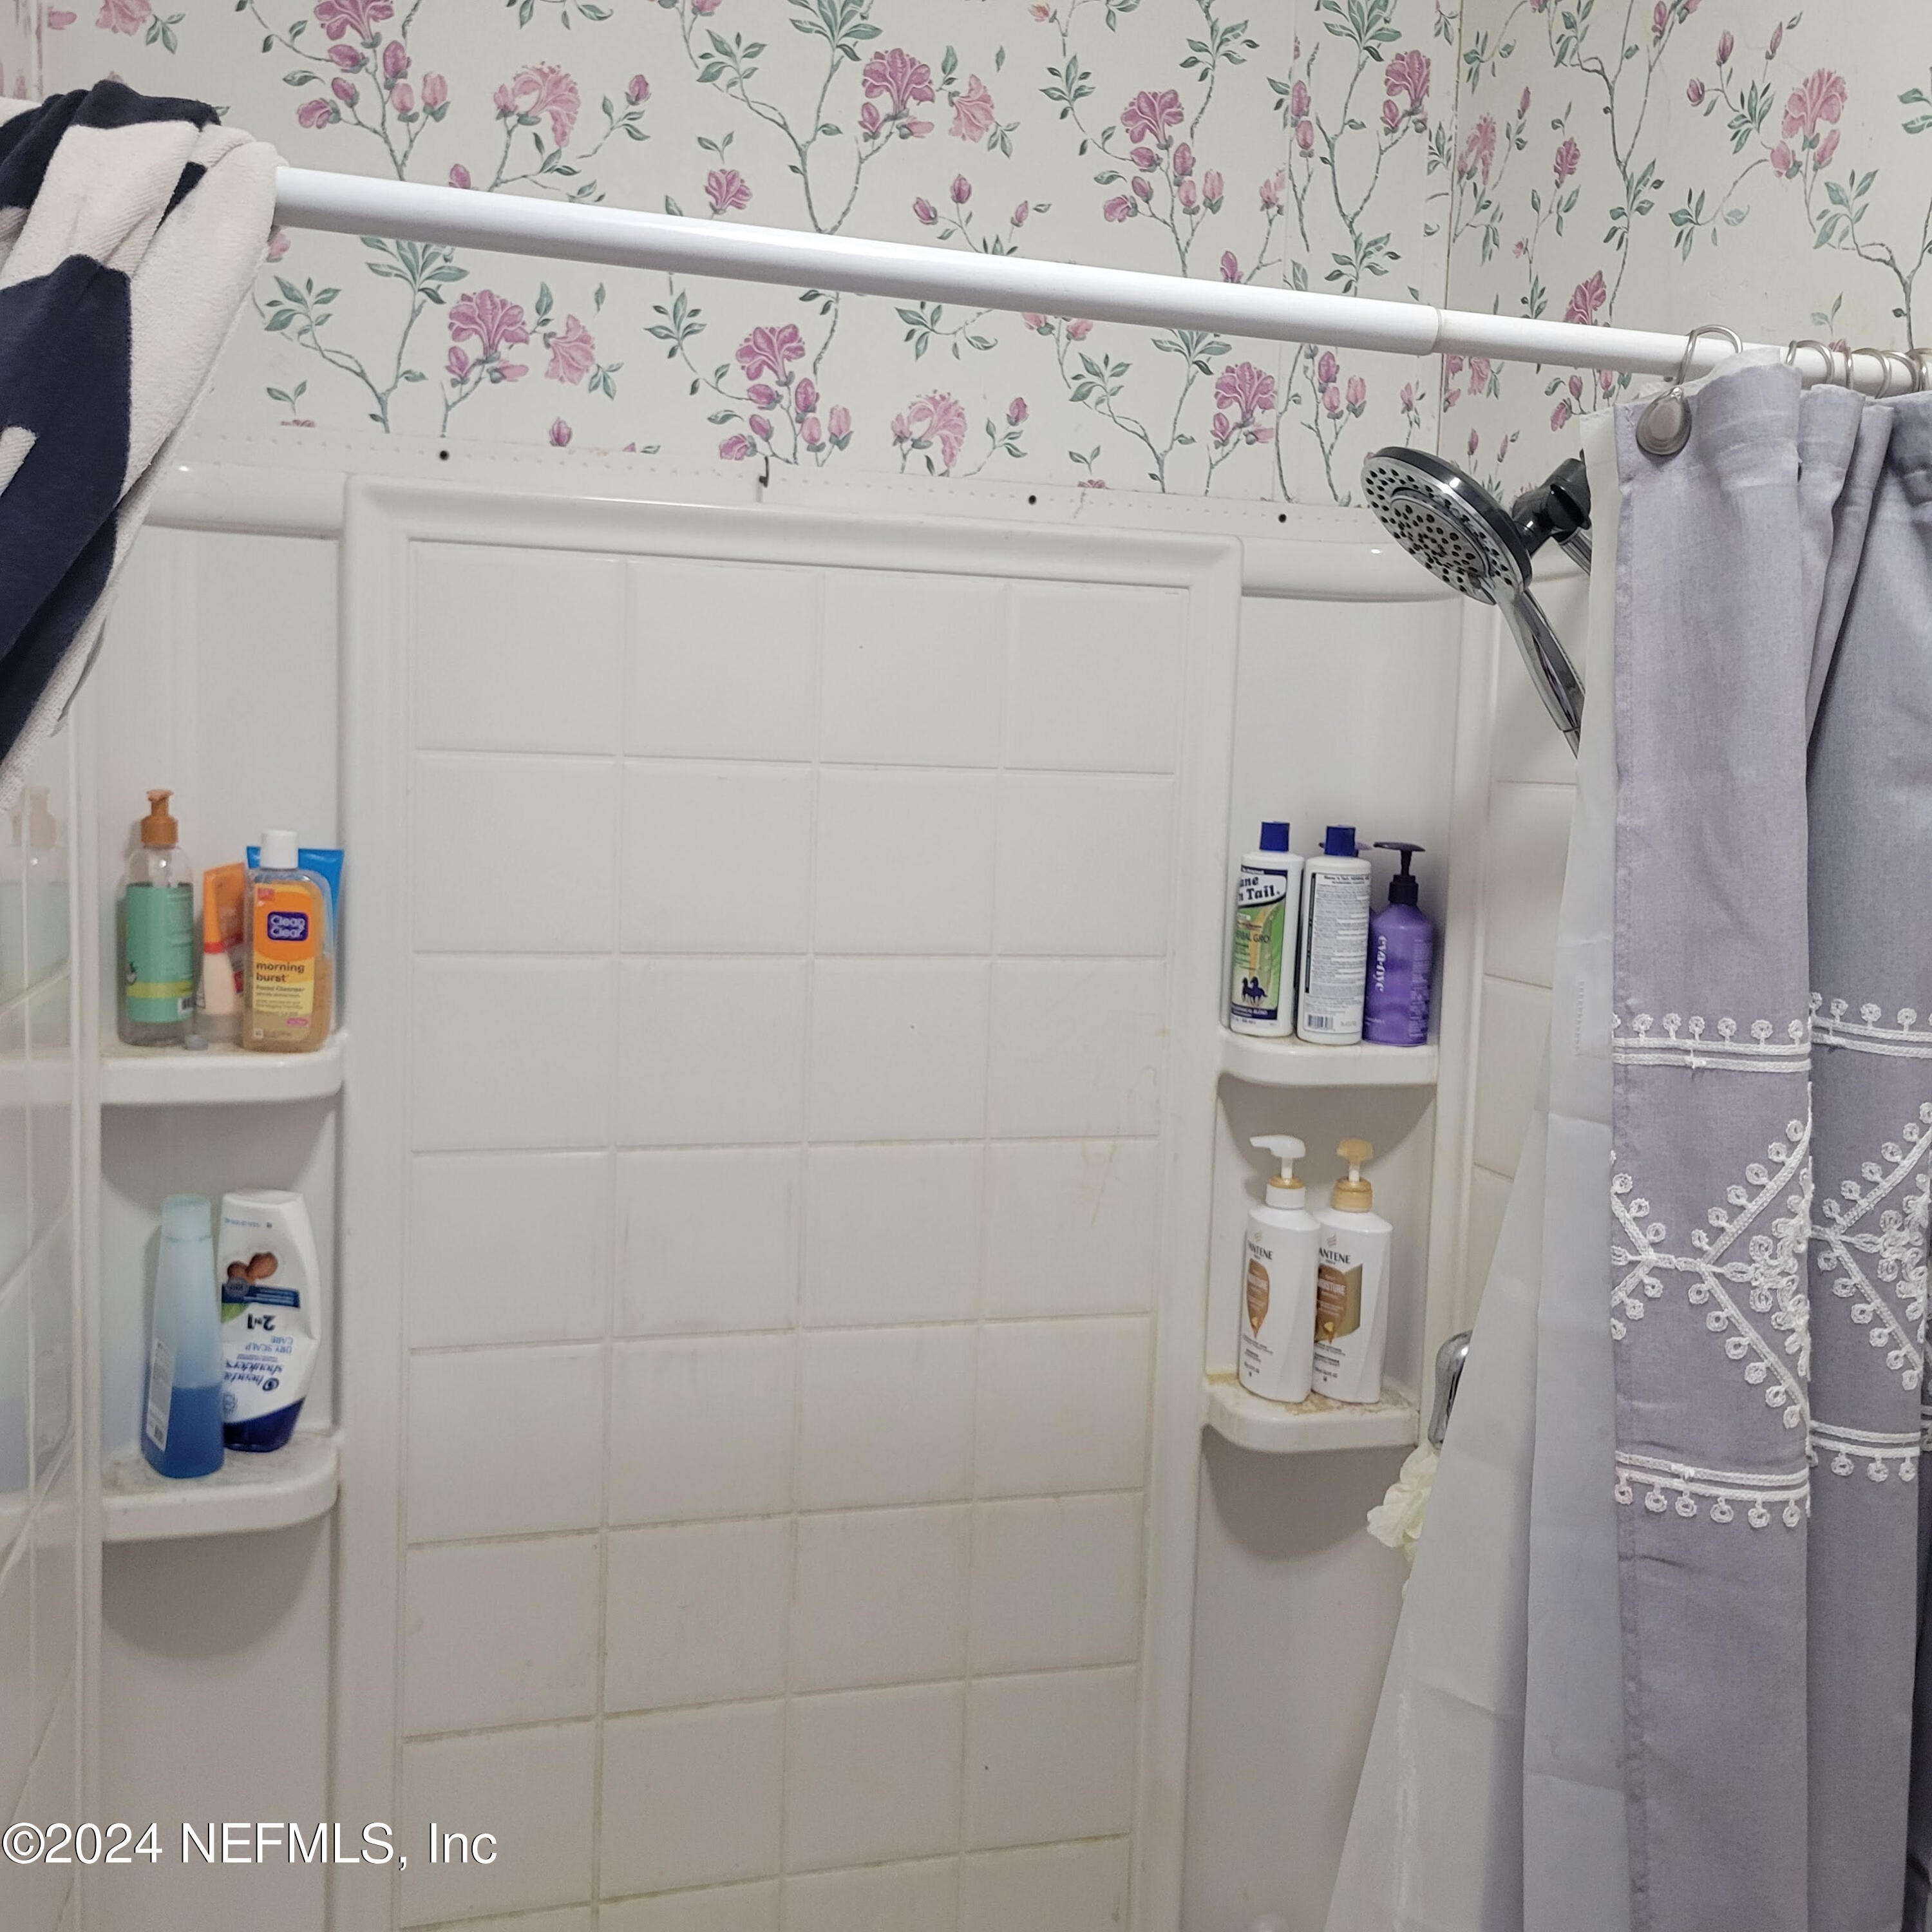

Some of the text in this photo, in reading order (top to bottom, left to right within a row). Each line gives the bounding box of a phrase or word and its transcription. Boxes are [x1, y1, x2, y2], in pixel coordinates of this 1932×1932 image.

[1246, 884, 1275, 900] Tail
[256, 961, 305, 974] morning
[256, 972, 287, 983] burst
[1319, 1247, 1350, 1264] ANTENE
